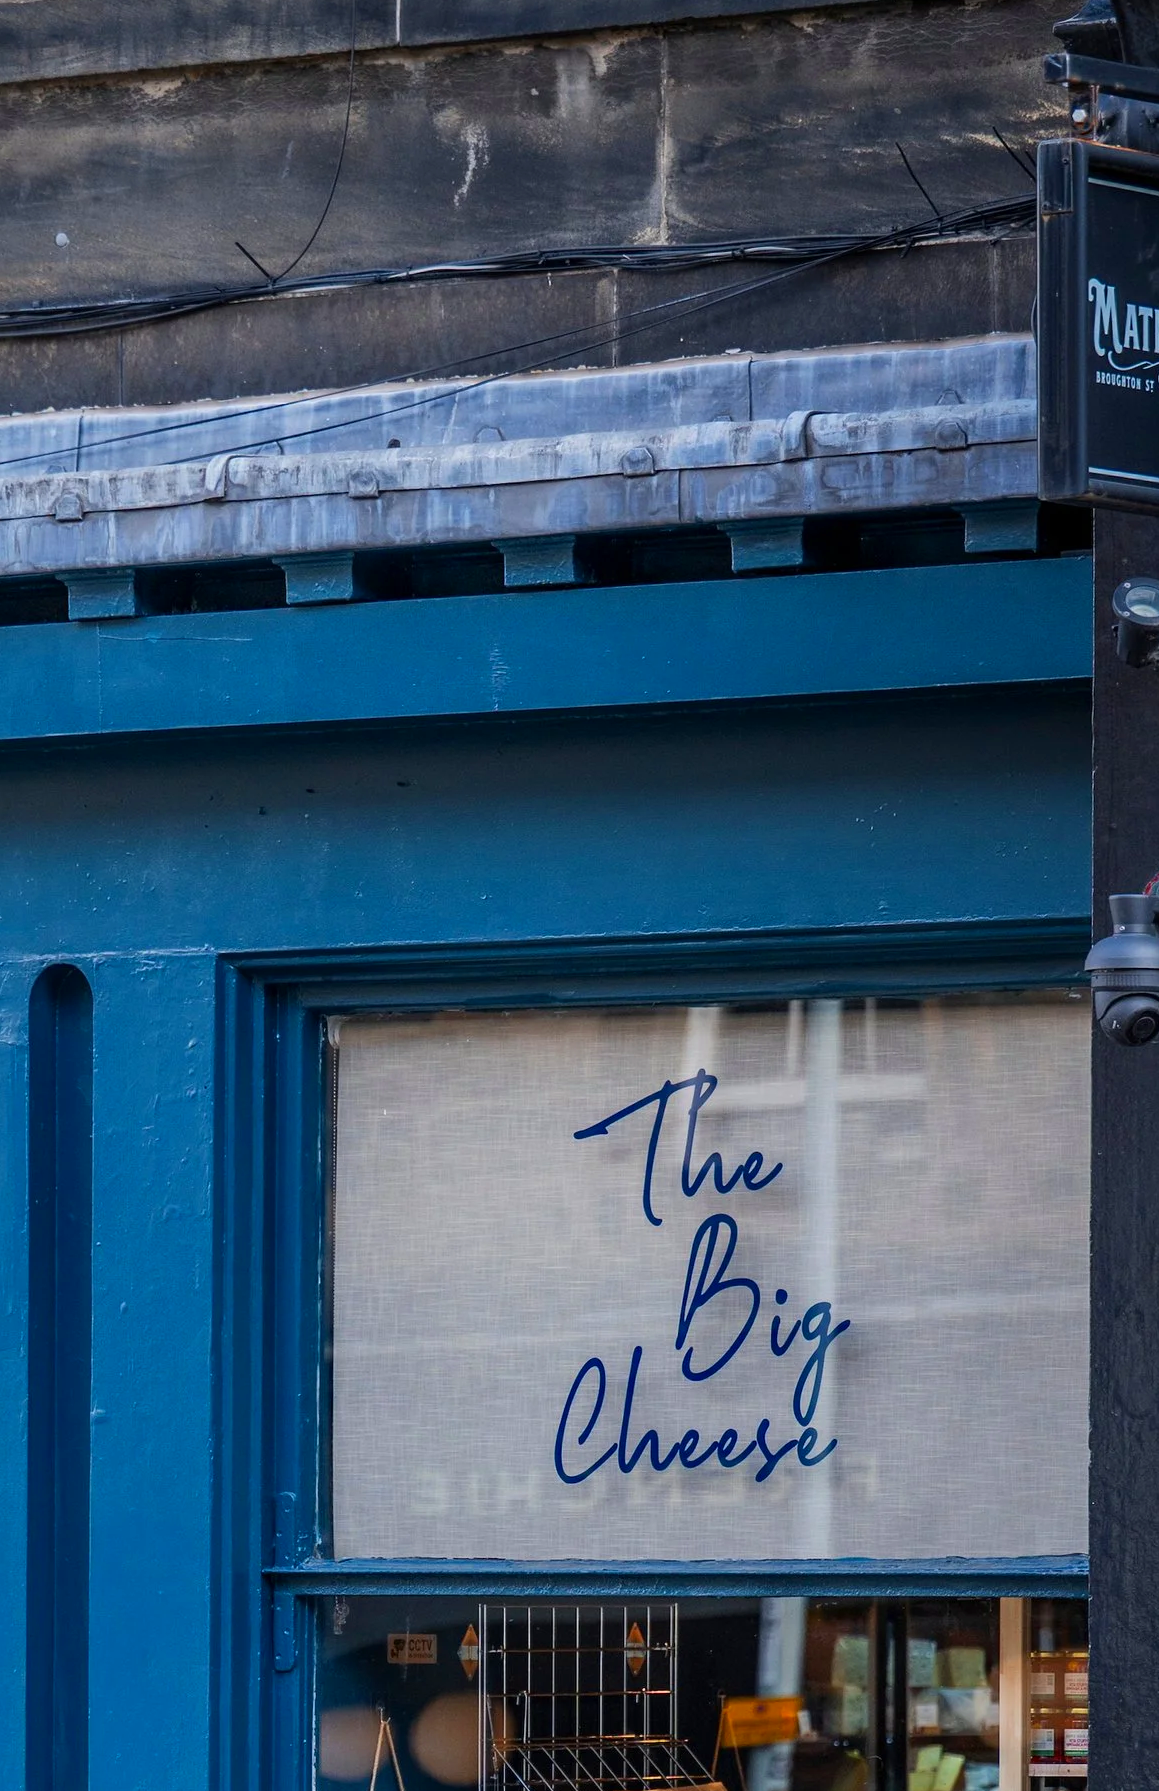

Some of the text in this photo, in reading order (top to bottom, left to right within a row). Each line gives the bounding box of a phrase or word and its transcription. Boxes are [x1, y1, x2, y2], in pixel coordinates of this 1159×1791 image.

[1096, 371, 1141, 390] BROUGHTON
[573, 1068, 783, 1226] The
[675, 1213, 850, 1427] Big
[553, 1346, 838, 1484] Cheese
[408, 1639, 433, 1651] CCTV
